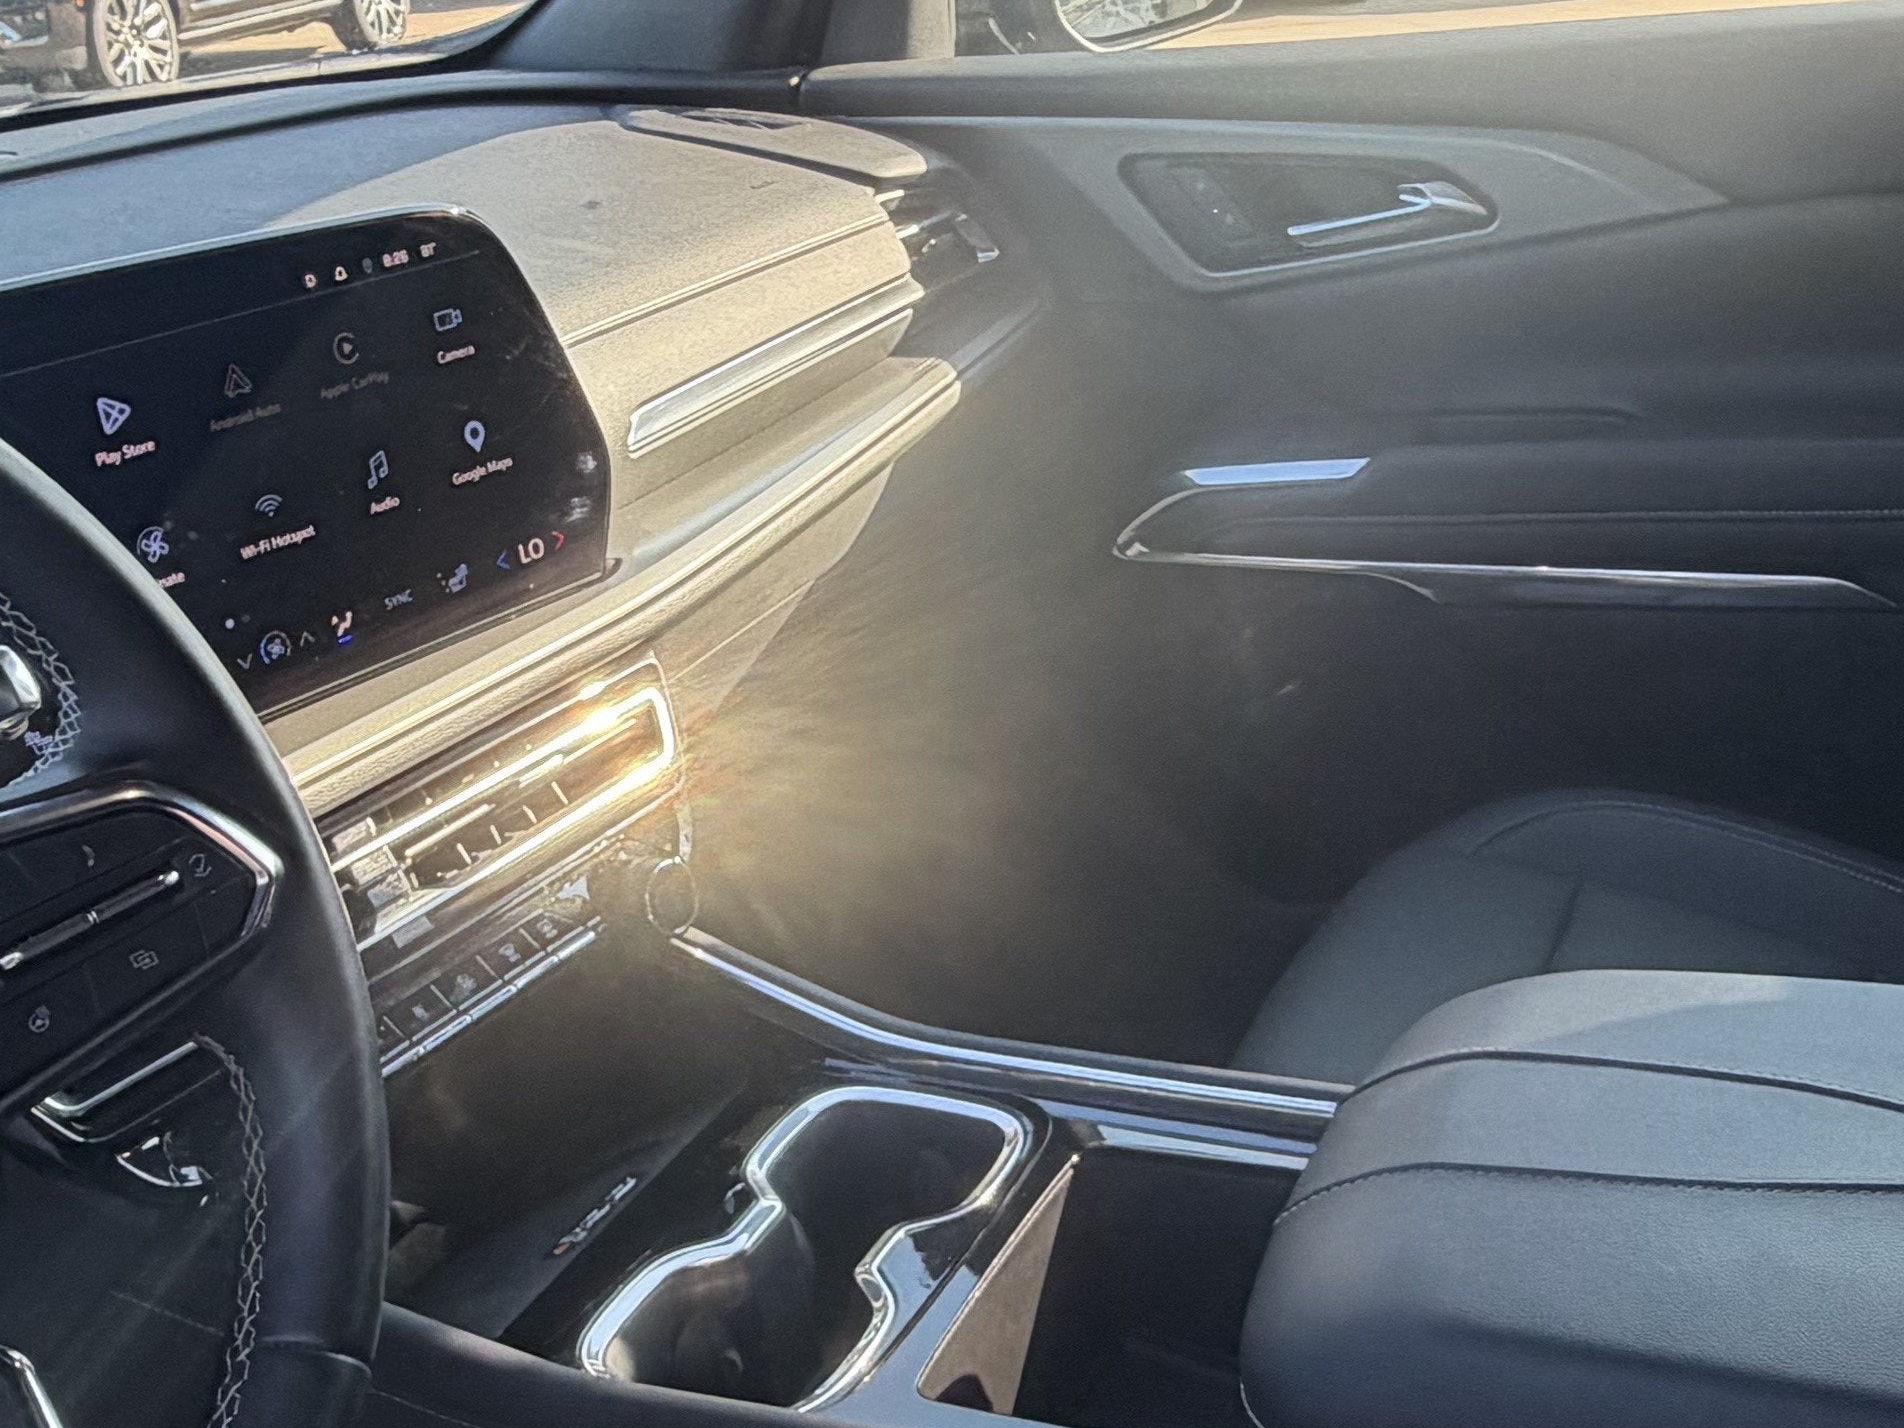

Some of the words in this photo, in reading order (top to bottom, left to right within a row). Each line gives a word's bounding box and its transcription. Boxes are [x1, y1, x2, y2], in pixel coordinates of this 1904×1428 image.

[95, 451, 122, 467] Play
[122, 440, 156, 460] Store
[517, 537, 545, 566] LO
